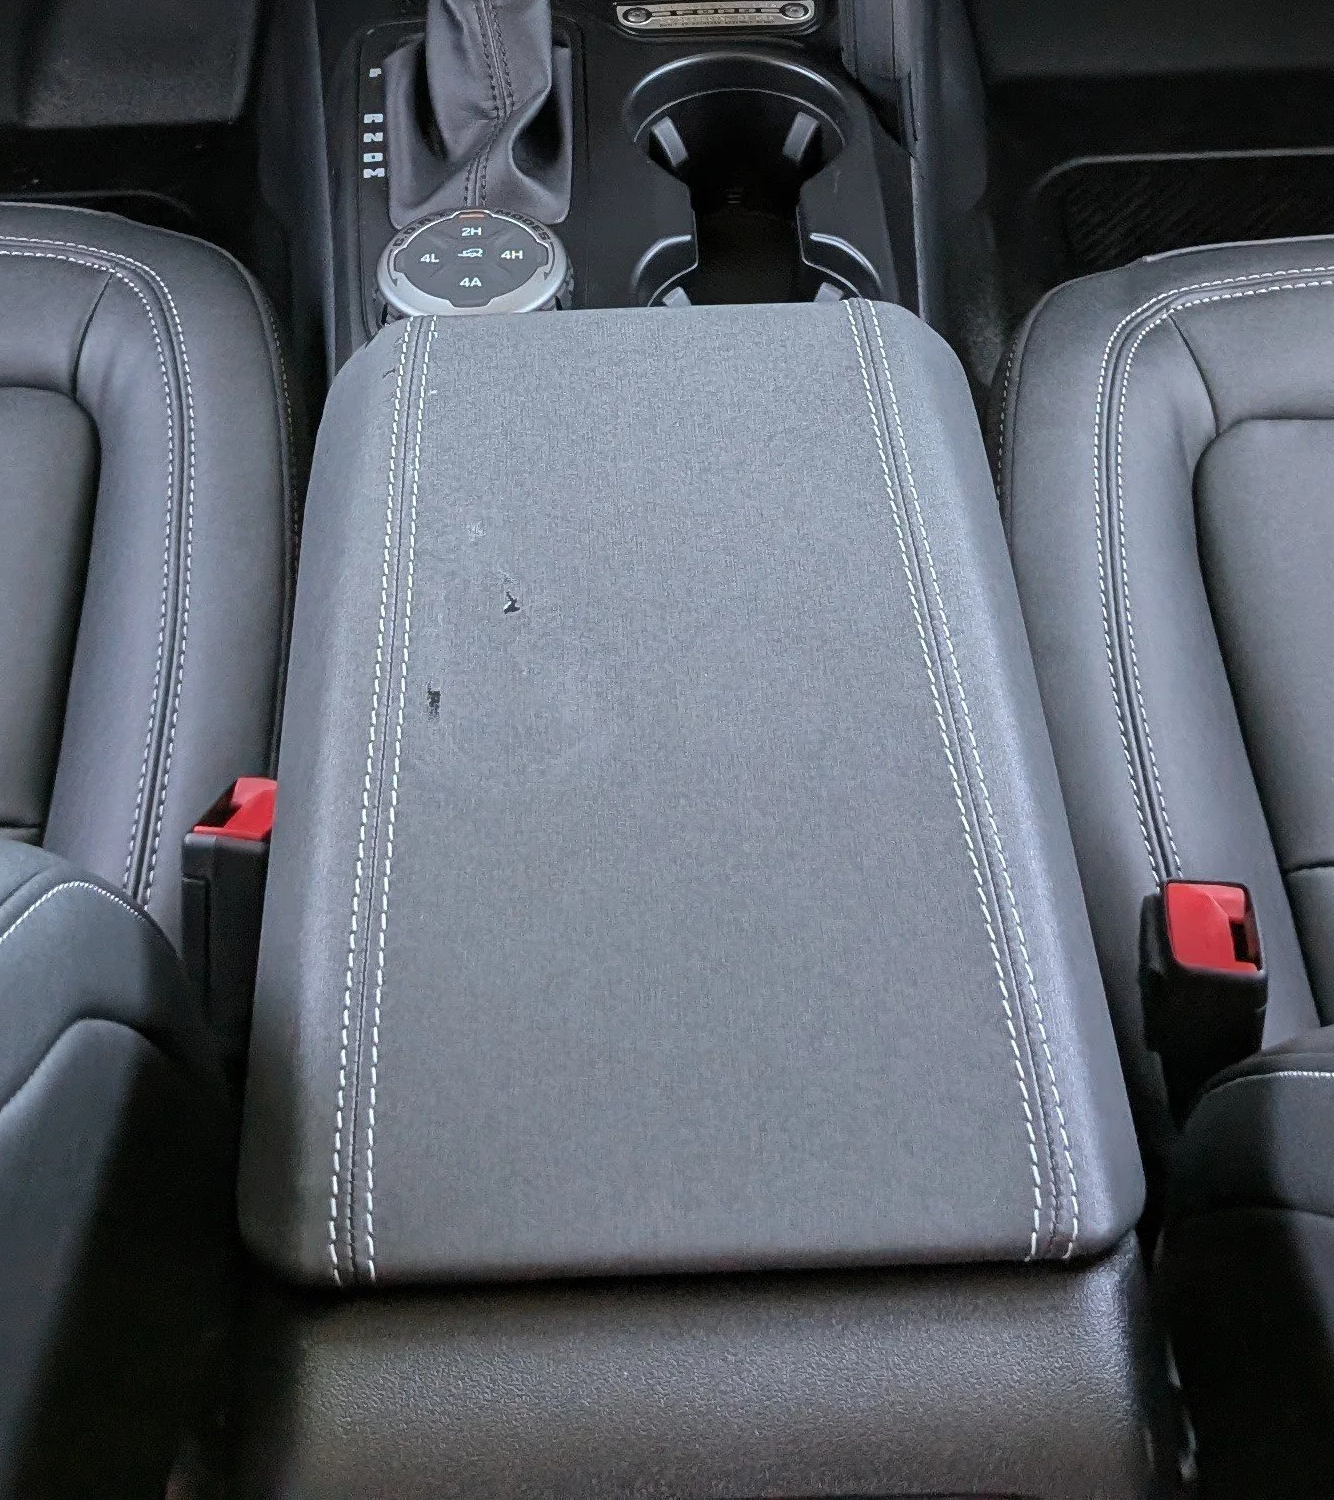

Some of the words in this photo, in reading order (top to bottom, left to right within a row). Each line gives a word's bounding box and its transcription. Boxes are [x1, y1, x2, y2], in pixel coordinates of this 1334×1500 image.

[363, 132, 383, 143] N
[363, 167, 385, 179] M
[495, 208, 551, 241] MODES
[461, 227, 482, 236] 2H
[420, 253, 439, 263] 4L
[501, 249, 523, 259] 4H
[459, 277, 482, 287] 4A
